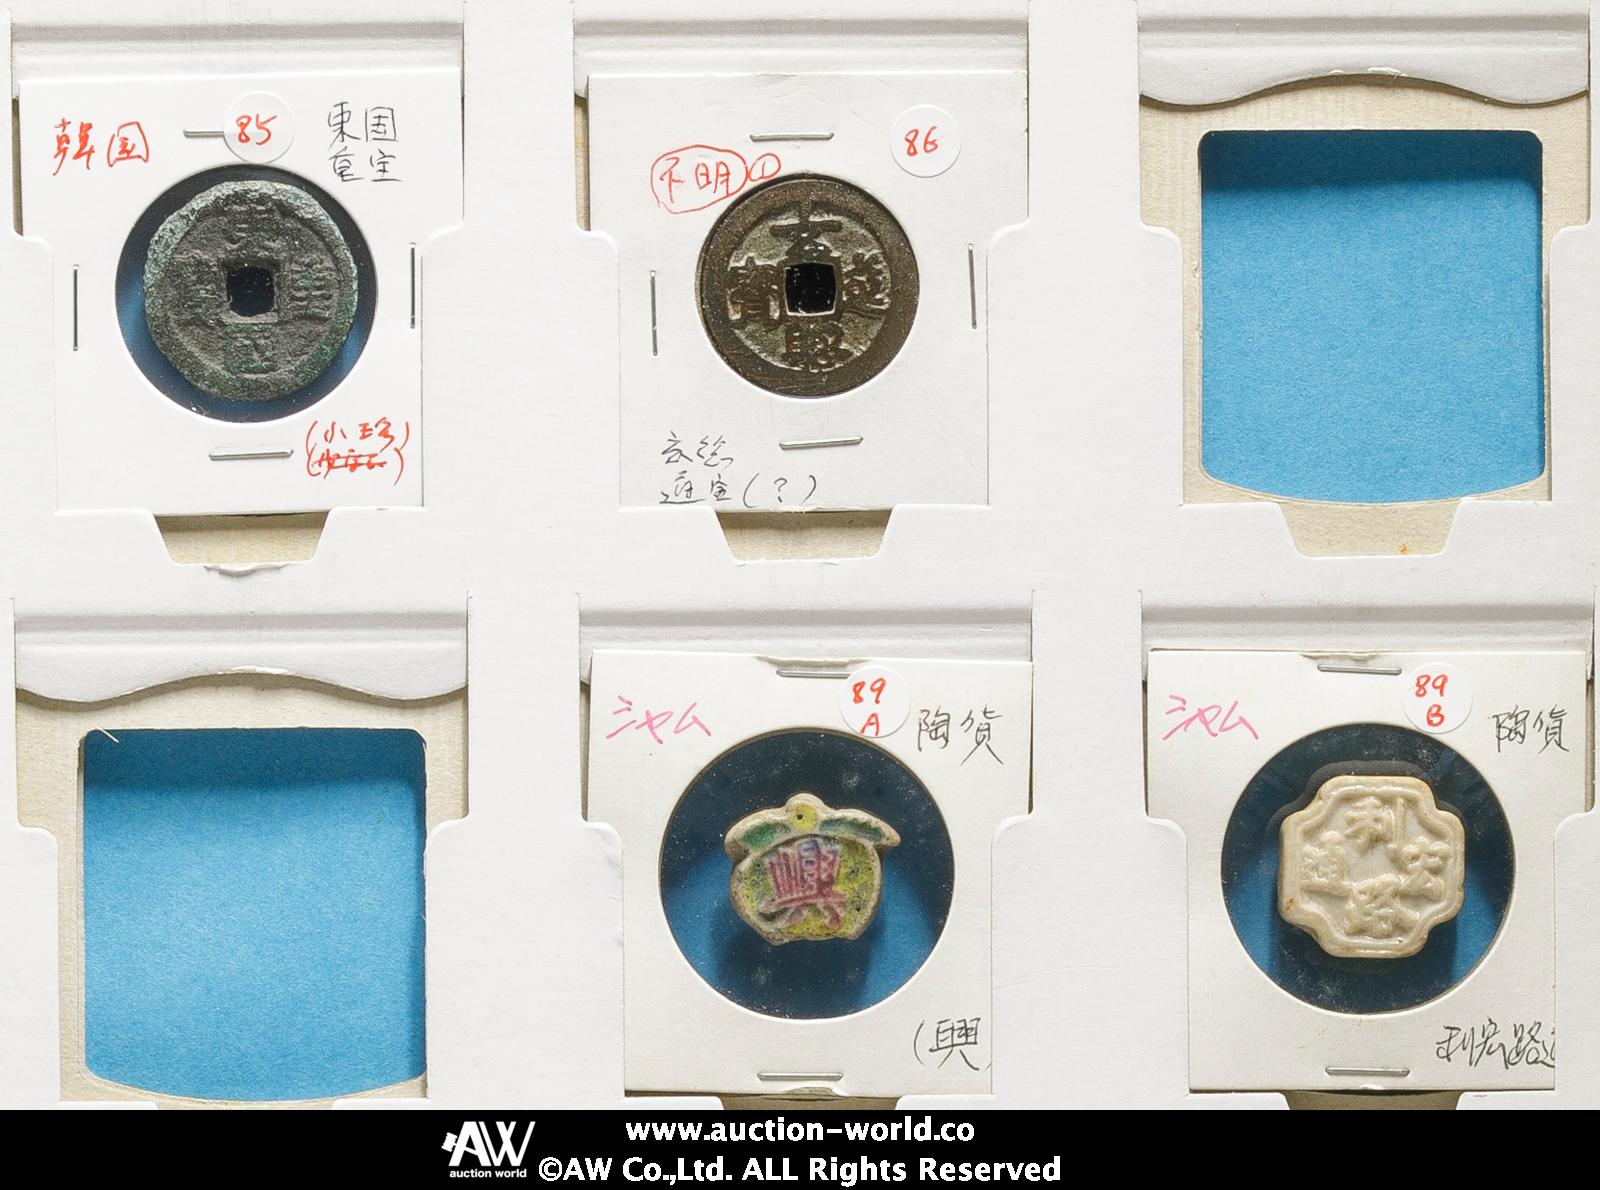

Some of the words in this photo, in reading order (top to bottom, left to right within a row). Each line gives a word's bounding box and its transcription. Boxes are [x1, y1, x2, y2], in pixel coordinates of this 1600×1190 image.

[52, 117, 150, 177] 韓国
[236, 115, 277, 145] 85
[904, 126, 940, 158] 86
[659, 156, 731, 204] 不明
[852, 677, 887, 705] 89
[1415, 673, 1449, 699] 89
[606, 695, 711, 744] シャム
[859, 712, 880, 737] A
[917, 705, 1005, 766] 陶貨
[1163, 694, 1259, 741] シャム
[1425, 704, 1446, 728] B
[1492, 704, 1570, 754] 陶貨
[913, 1017, 991, 1072] (興
